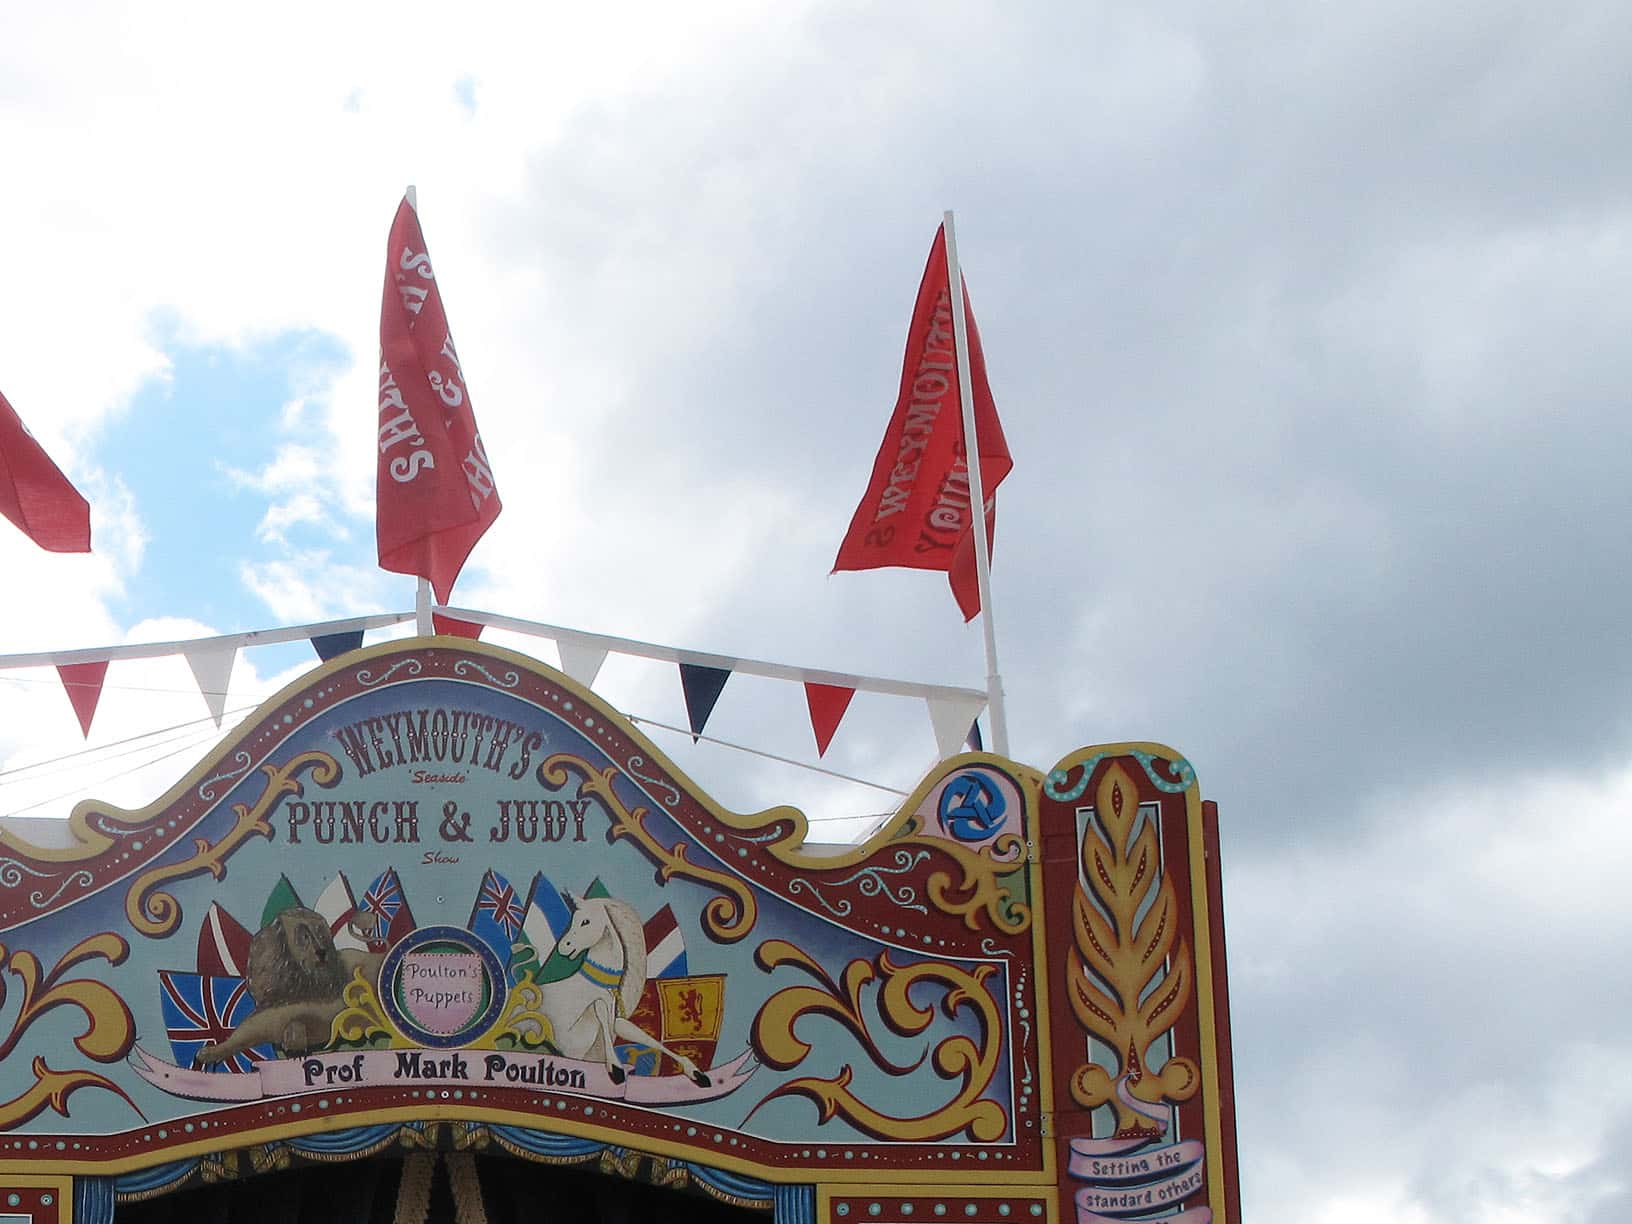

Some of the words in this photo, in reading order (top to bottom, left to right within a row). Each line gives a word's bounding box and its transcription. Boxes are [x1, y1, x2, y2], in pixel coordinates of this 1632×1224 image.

[332, 708, 543, 781] WEYMOUTH'S
[285, 801, 420, 843] PUNCH
[439, 801, 474, 843] &
[490, 800, 591, 844] JUDY
[421, 851, 460, 865] Show
[406, 963, 478, 979] Poulton's
[410, 988, 473, 1009] Puppets
[302, 1055, 364, 1086] Prof
[393, 1052, 469, 1080] Mark
[484, 1054, 586, 1089] Poulton
[1092, 1159, 1150, 1176] Setting
[1157, 1151, 1182, 1167] the
[1087, 1191, 1152, 1208] standard
[1159, 1172, 1202, 1200] others
